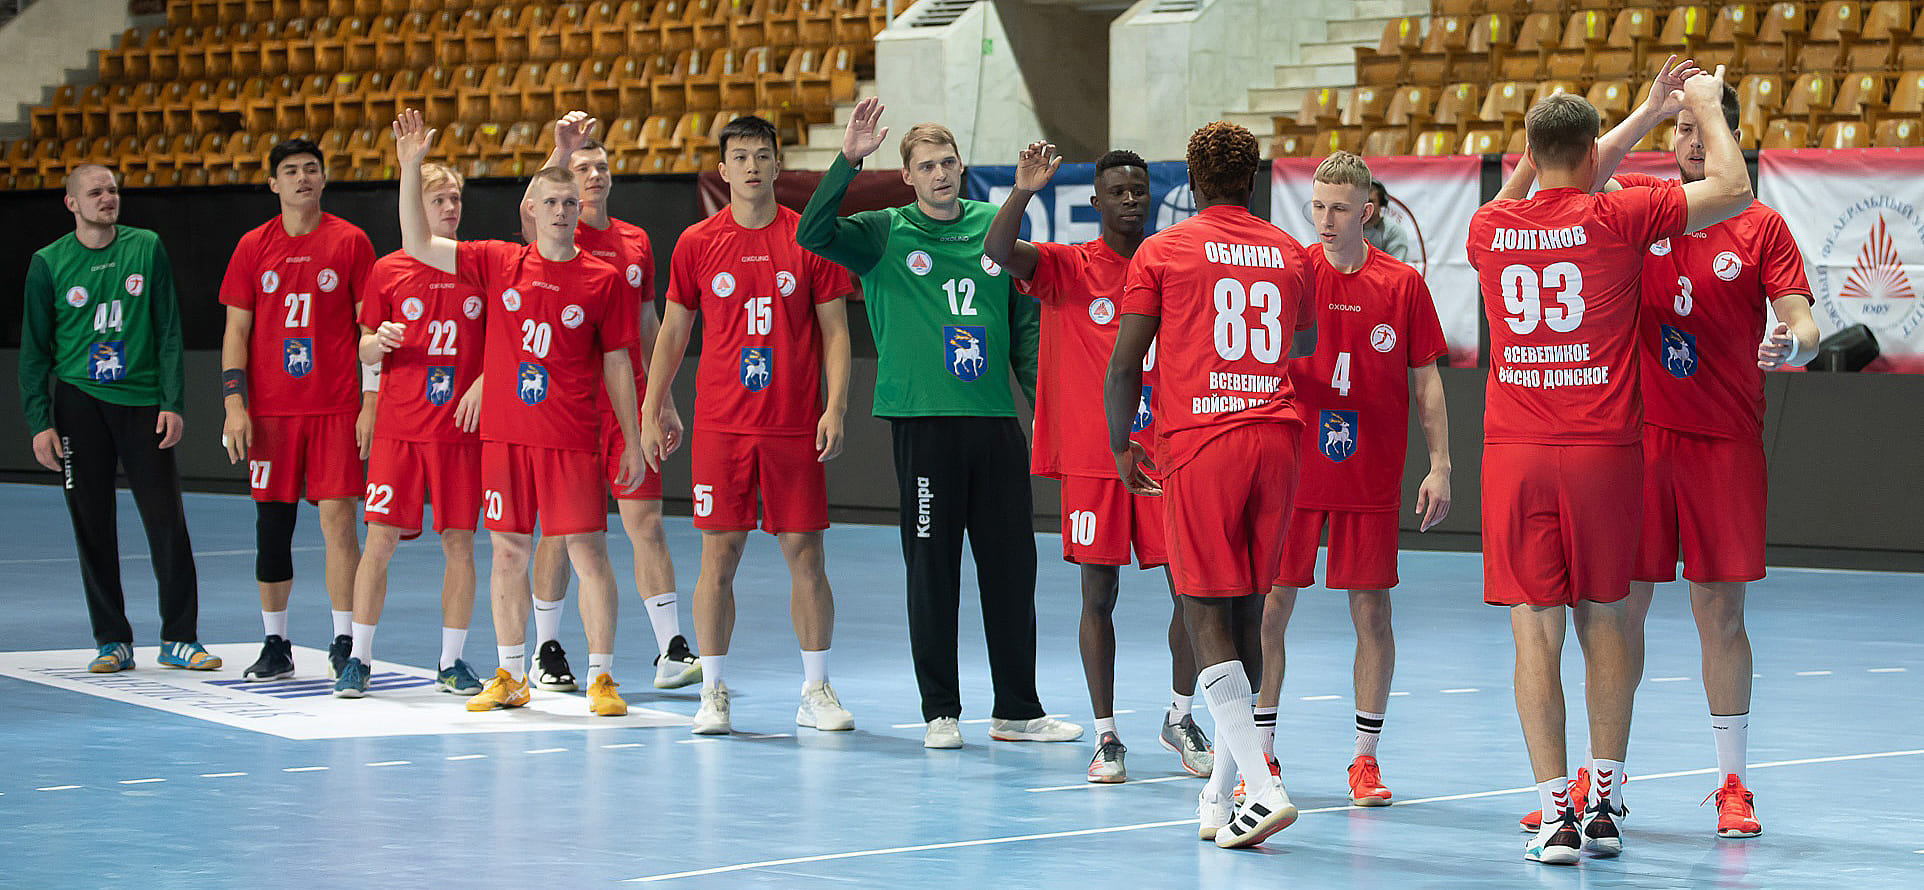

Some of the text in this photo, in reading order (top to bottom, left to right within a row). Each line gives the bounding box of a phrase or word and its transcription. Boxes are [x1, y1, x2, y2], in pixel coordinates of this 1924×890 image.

[1490, 225, 1588, 253] ДОЛГАНОВ
[1821, 195, 1914, 258] ФЕДЕРАЛЬНЫЙ
[1204, 241, 1285, 269] ОБИННА
[283, 292, 312, 329] 27
[941, 277, 979, 316] 12
[1328, 303, 1362, 313] OXOUNO
[1500, 261, 1587, 335] 93
[1673, 275, 1693, 317] 3
[93, 299, 123, 335] 44
[743, 295, 773, 336] 15
[1213, 277, 1283, 364] 83
[427, 319, 458, 357] 22
[521, 318, 553, 360] 20
[1209, 371, 1282, 394] ВСЕВЕЛИКО
[1330, 351, 1351, 397] 4
[1543, 365, 1609, 391] ДОНСКОЕ
[250, 459, 272, 490] 27
[365, 482, 394, 515] 22
[916, 476, 934, 539] Kempa
[1069, 509, 1097, 547] 10
